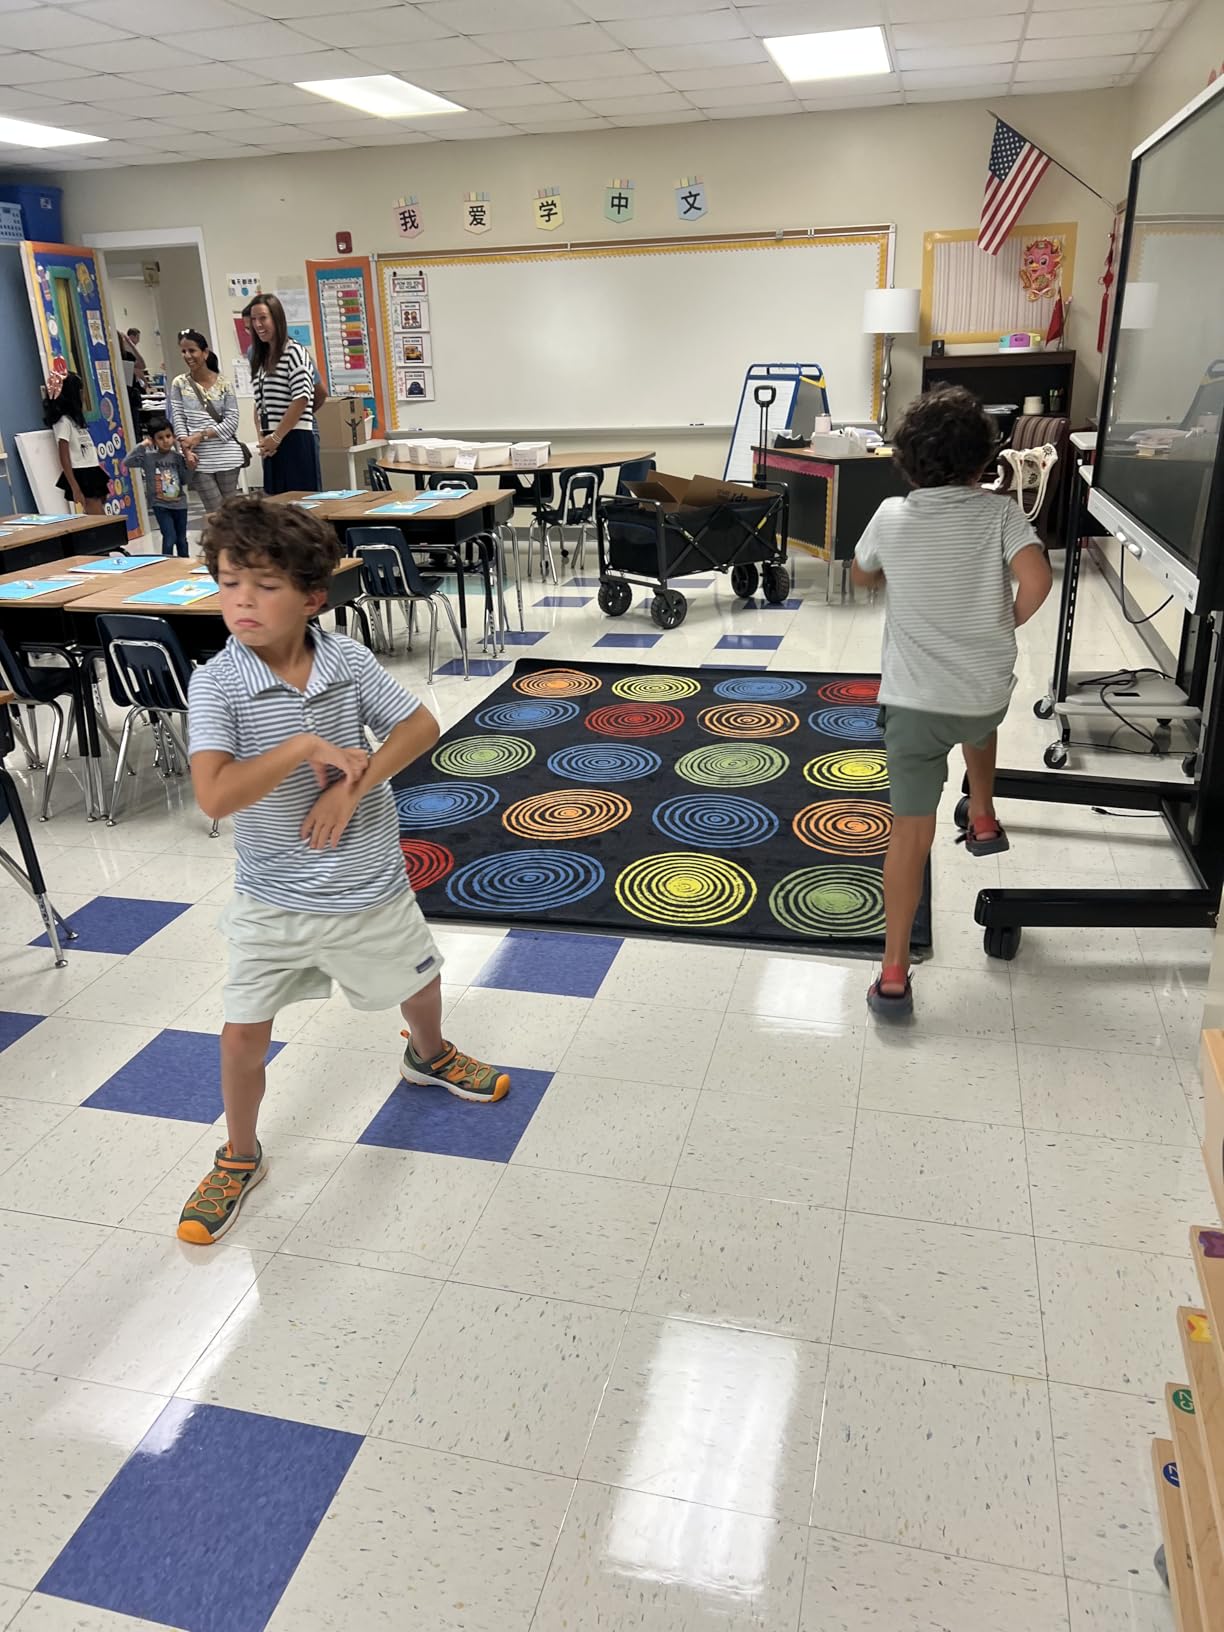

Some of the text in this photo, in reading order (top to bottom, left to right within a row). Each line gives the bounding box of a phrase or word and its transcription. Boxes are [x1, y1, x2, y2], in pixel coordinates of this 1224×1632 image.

[399, 190, 702, 232] 我 爱 学 中 文
